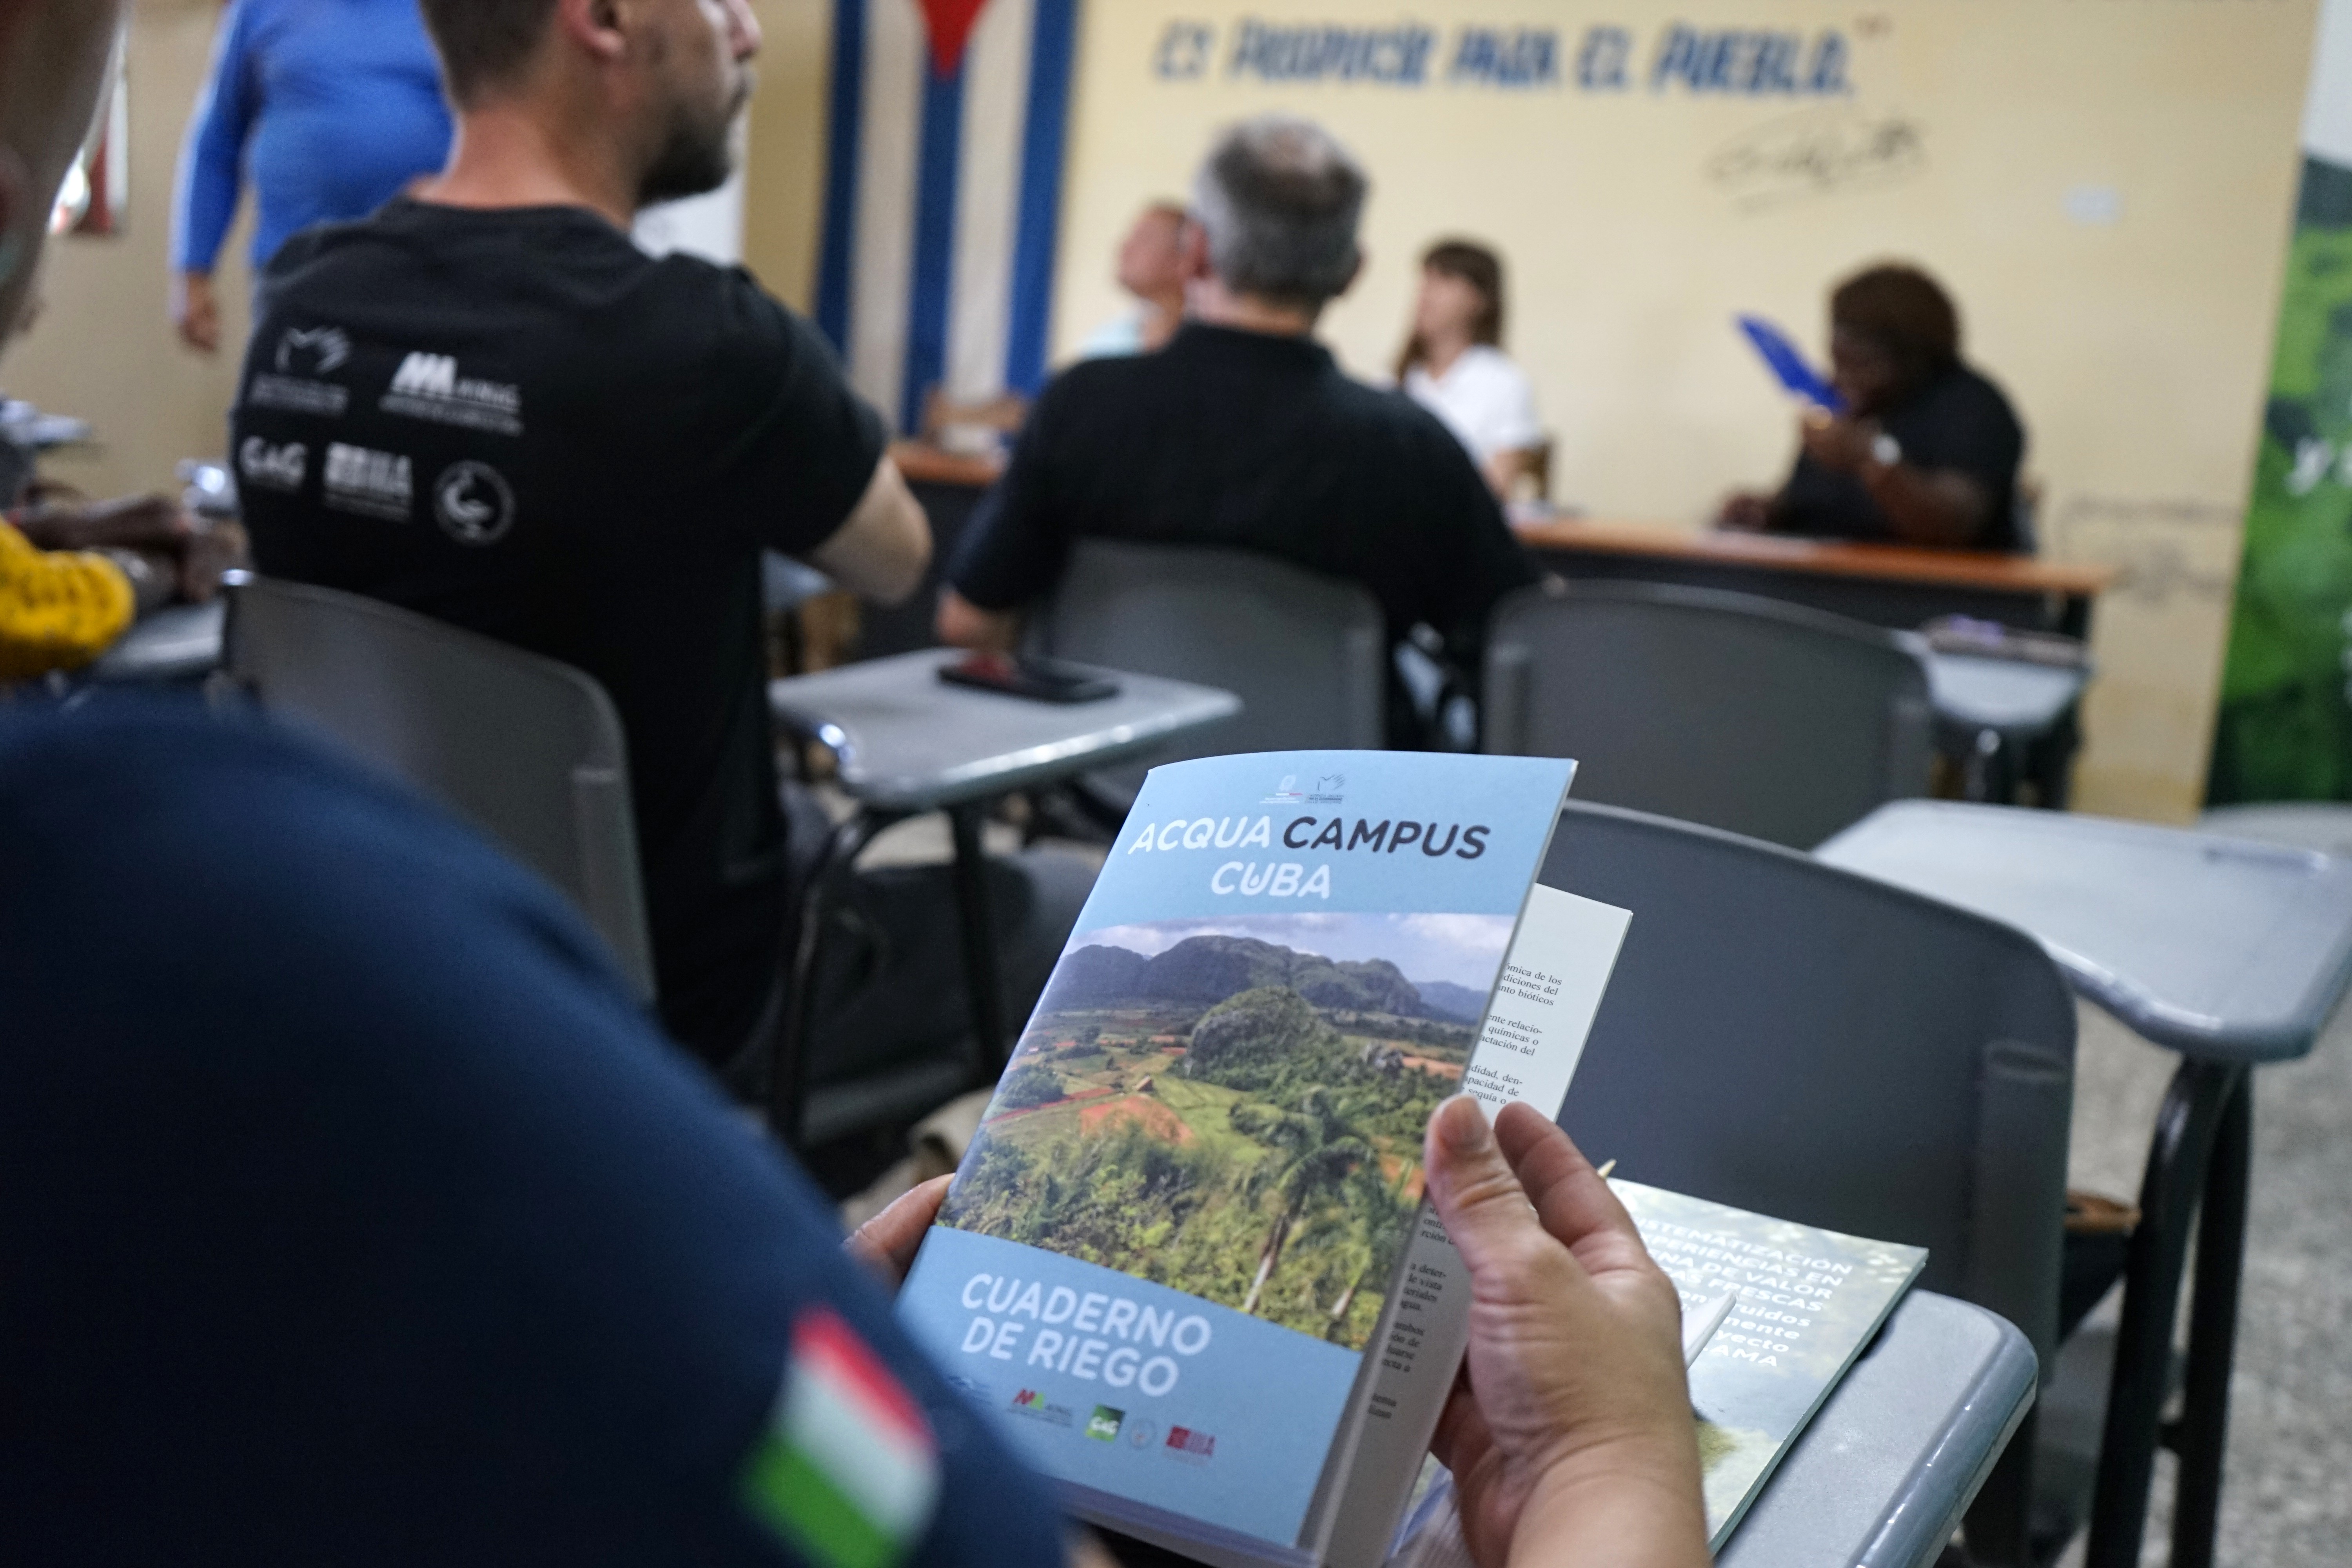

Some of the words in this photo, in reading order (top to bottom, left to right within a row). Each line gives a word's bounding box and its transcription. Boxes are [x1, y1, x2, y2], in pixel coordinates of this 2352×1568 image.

[1128, 815, 1270, 855] ACQUA
[1282, 815, 1491, 860] CAMPUS
[1210, 861, 1331, 900] CUBA
[1503, 974, 1541, 991] diciones
[1544, 985, 1559, 995] del
[1535, 972, 1546, 981] de
[1548, 975, 1562, 985] los
[1518, 989, 1554, 1006] bióticos
[1488, 1025, 1530, 1043] químicas
[1508, 1019, 1543, 1034] relacio-
[1521, 1046, 1535, 1056] del
[1503, 1074, 1523, 1085] den-
[1508, 1087, 1519, 1096] de
[1702, 1262, 1739, 1278] DE
[1746, 1271, 1833, 1299] VALOR
[1805, 1272, 1843, 1286] EN
[1708, 1278, 1824, 1312] FRESCAS
[961, 1272, 1213, 1356] CUADERNO
[961, 1316, 1025, 1361] DE
[1028, 1328, 1180, 1398] RIEGO
[1702, 1344, 1777, 1367] AMA
